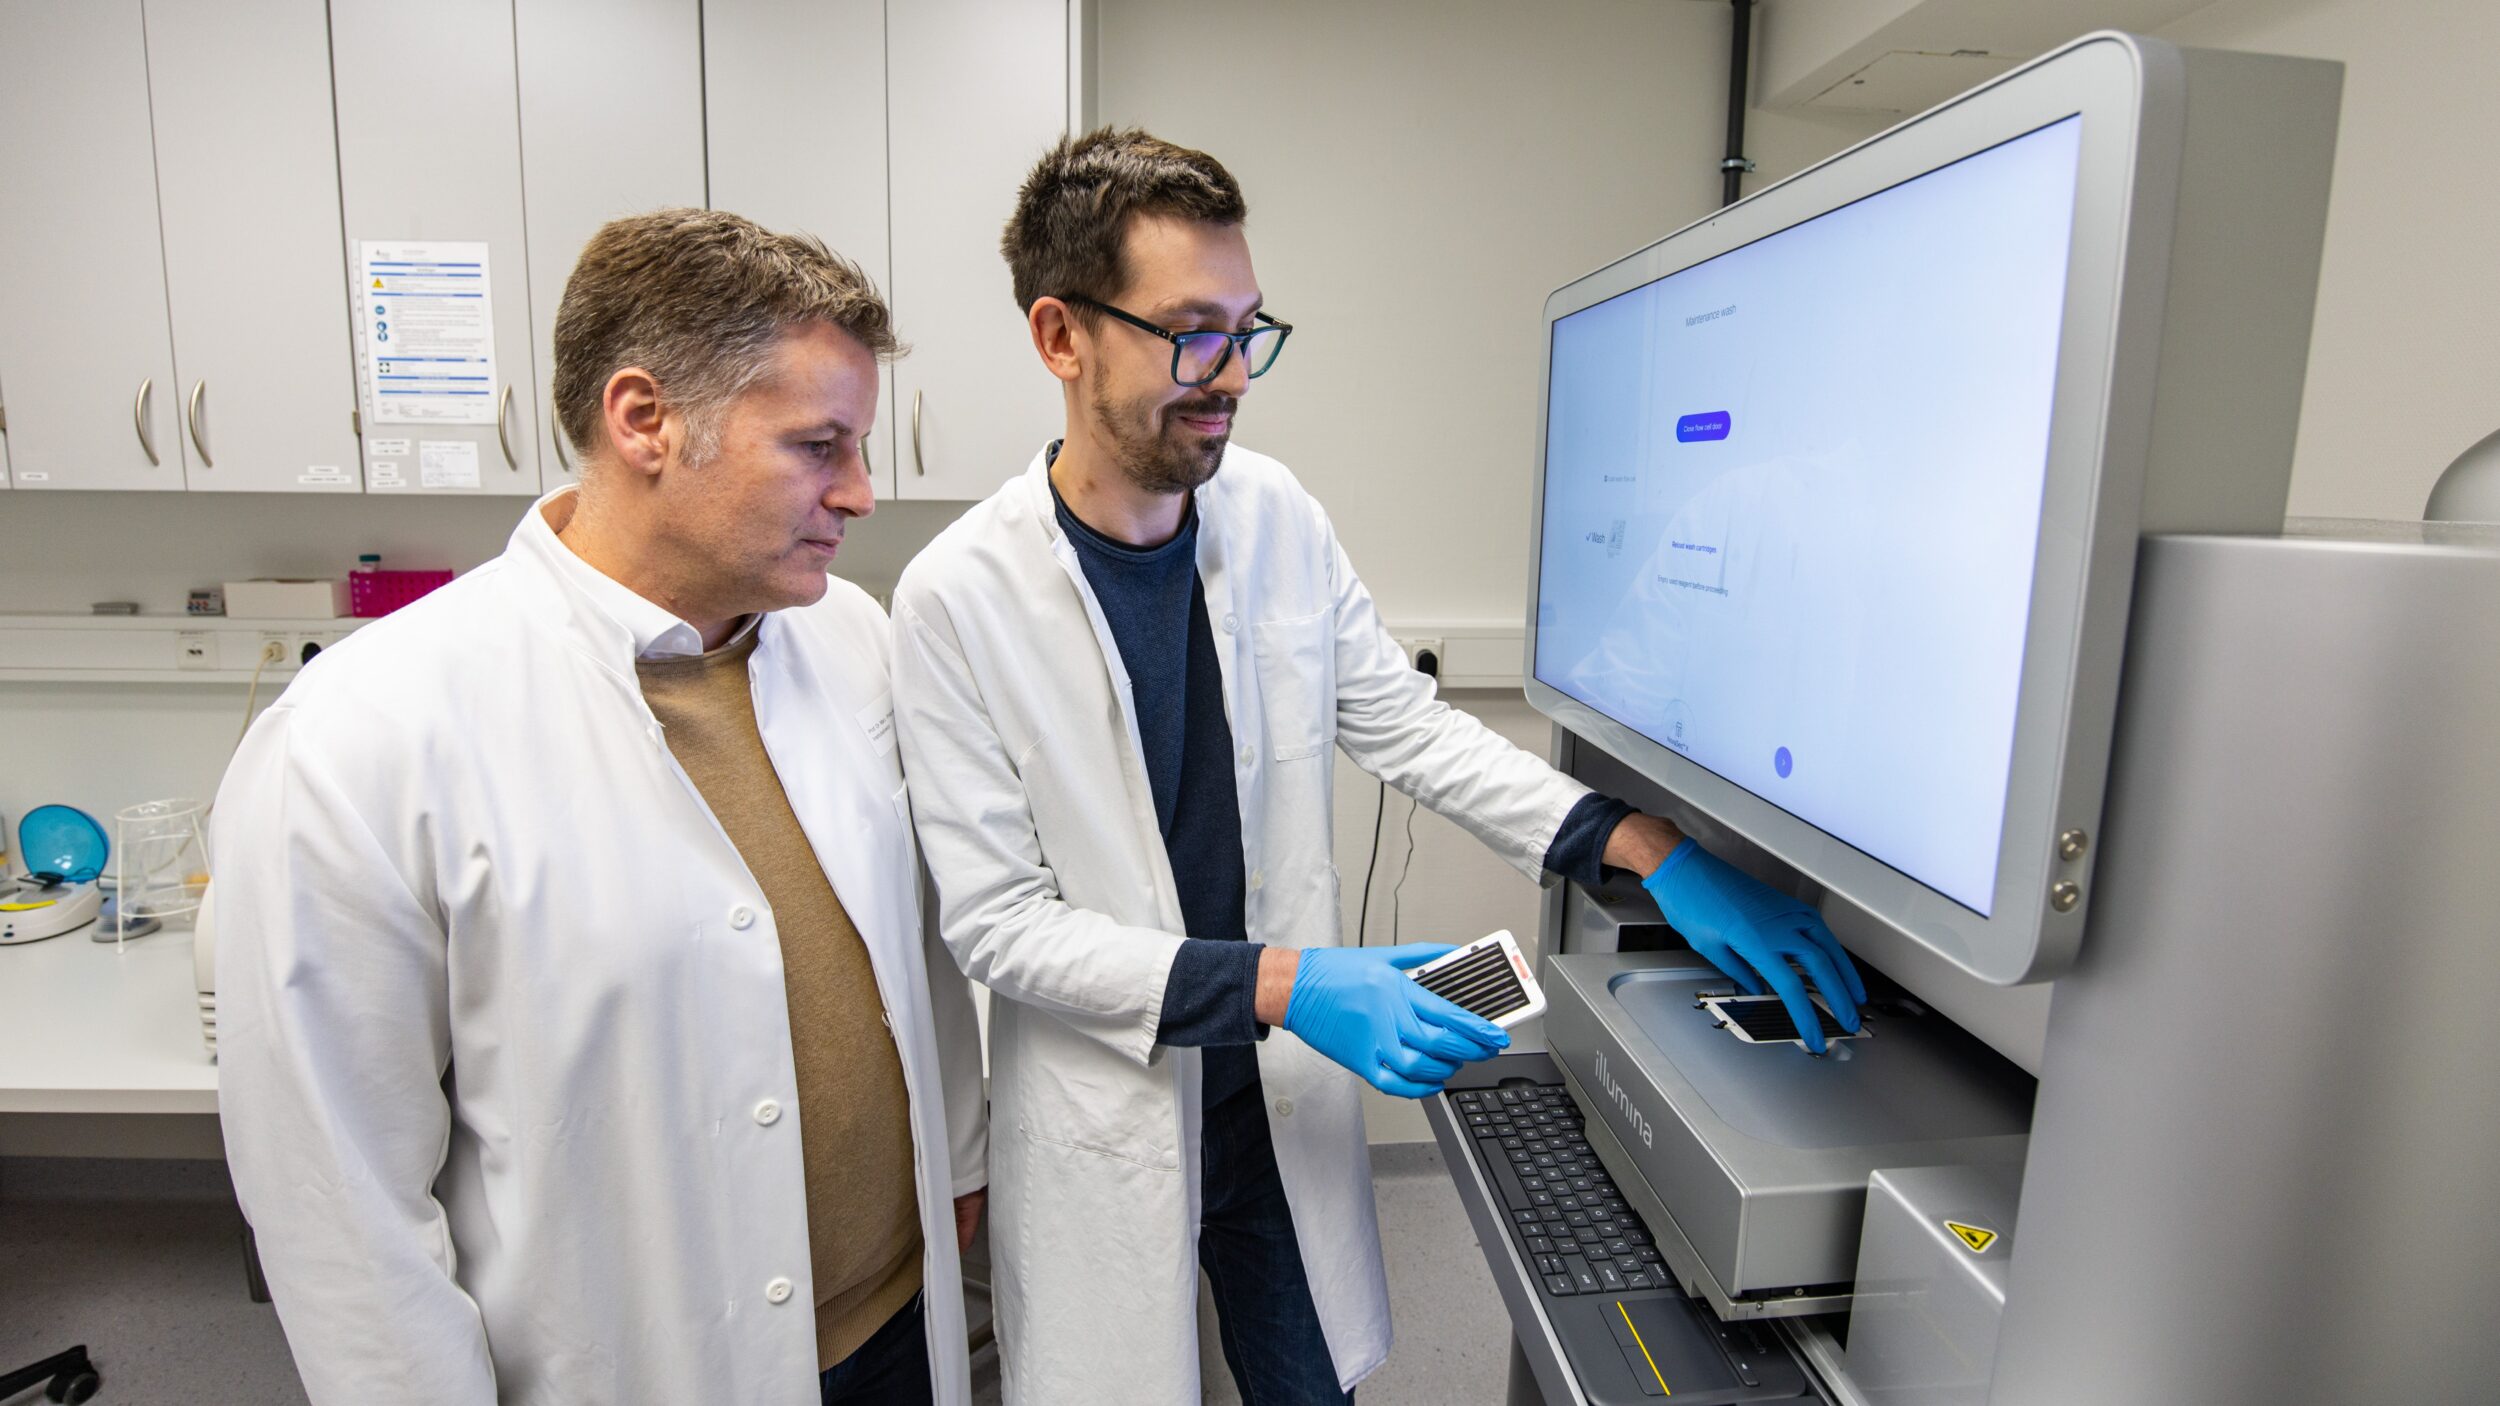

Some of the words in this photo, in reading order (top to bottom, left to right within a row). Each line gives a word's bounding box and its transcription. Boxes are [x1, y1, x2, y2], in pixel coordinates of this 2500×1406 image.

[1686, 310, 1720, 328] Maintenance
[1721, 303, 1736, 317] wash
[1592, 531, 1605, 544] Wash
[1595, 1049, 1652, 1150] illumina
